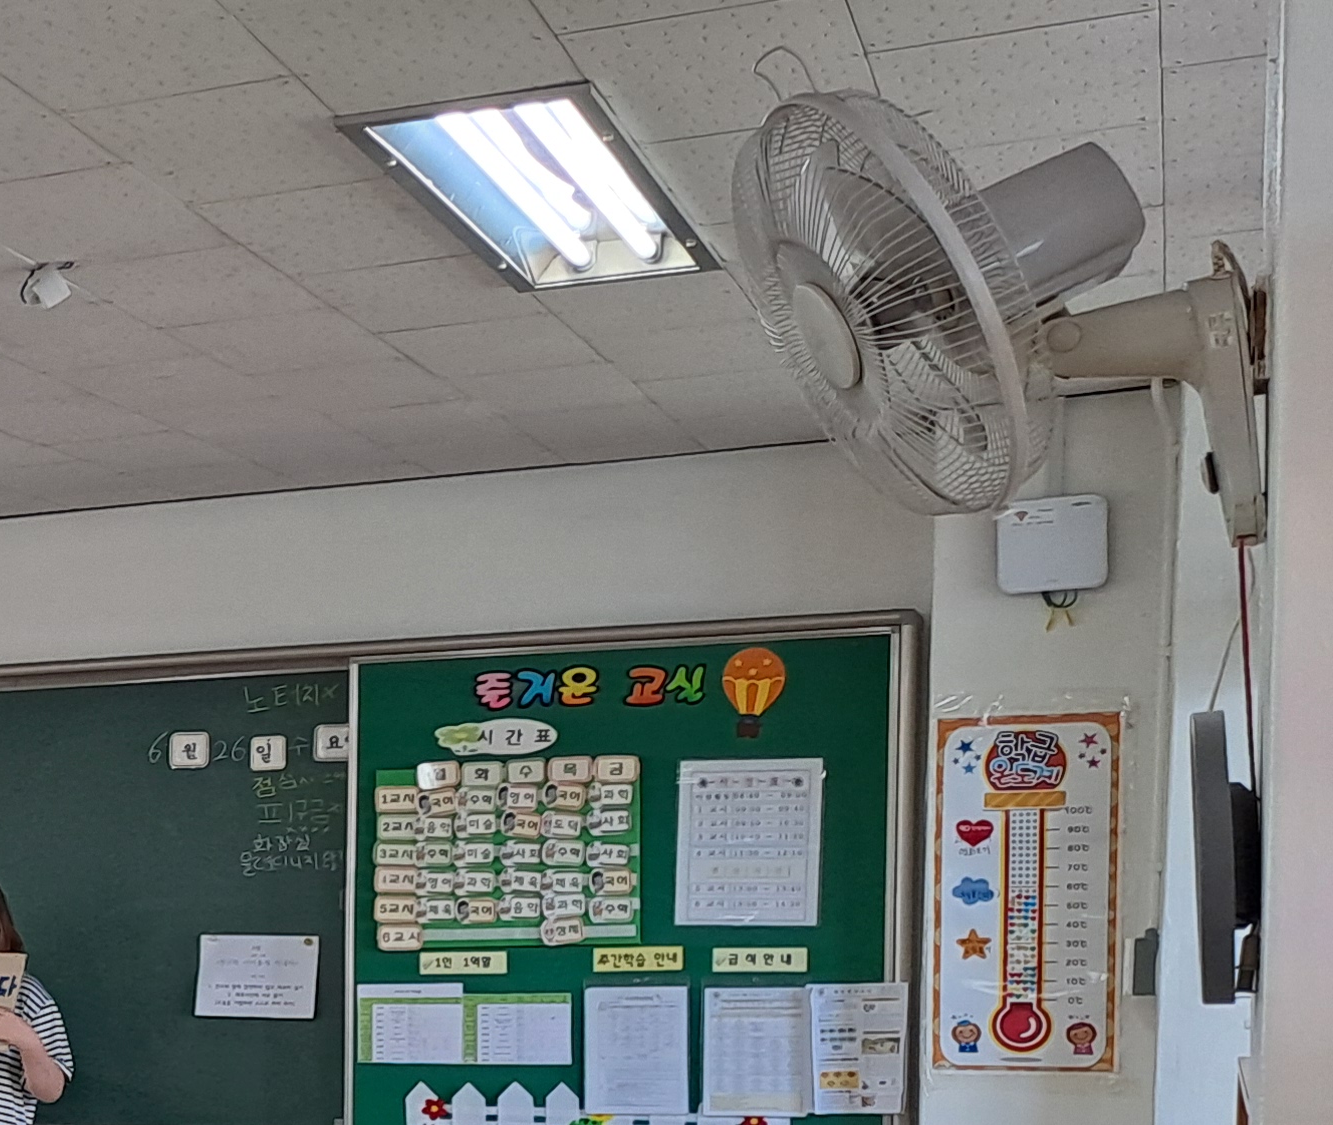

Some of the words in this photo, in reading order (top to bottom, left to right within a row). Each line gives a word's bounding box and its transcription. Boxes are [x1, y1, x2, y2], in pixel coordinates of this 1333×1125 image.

[474, 665, 598, 710] 즐거운
[623, 663, 707, 708] 교실
[326, 735, 349, 749] 요
[520, 765, 533, 778] 수
